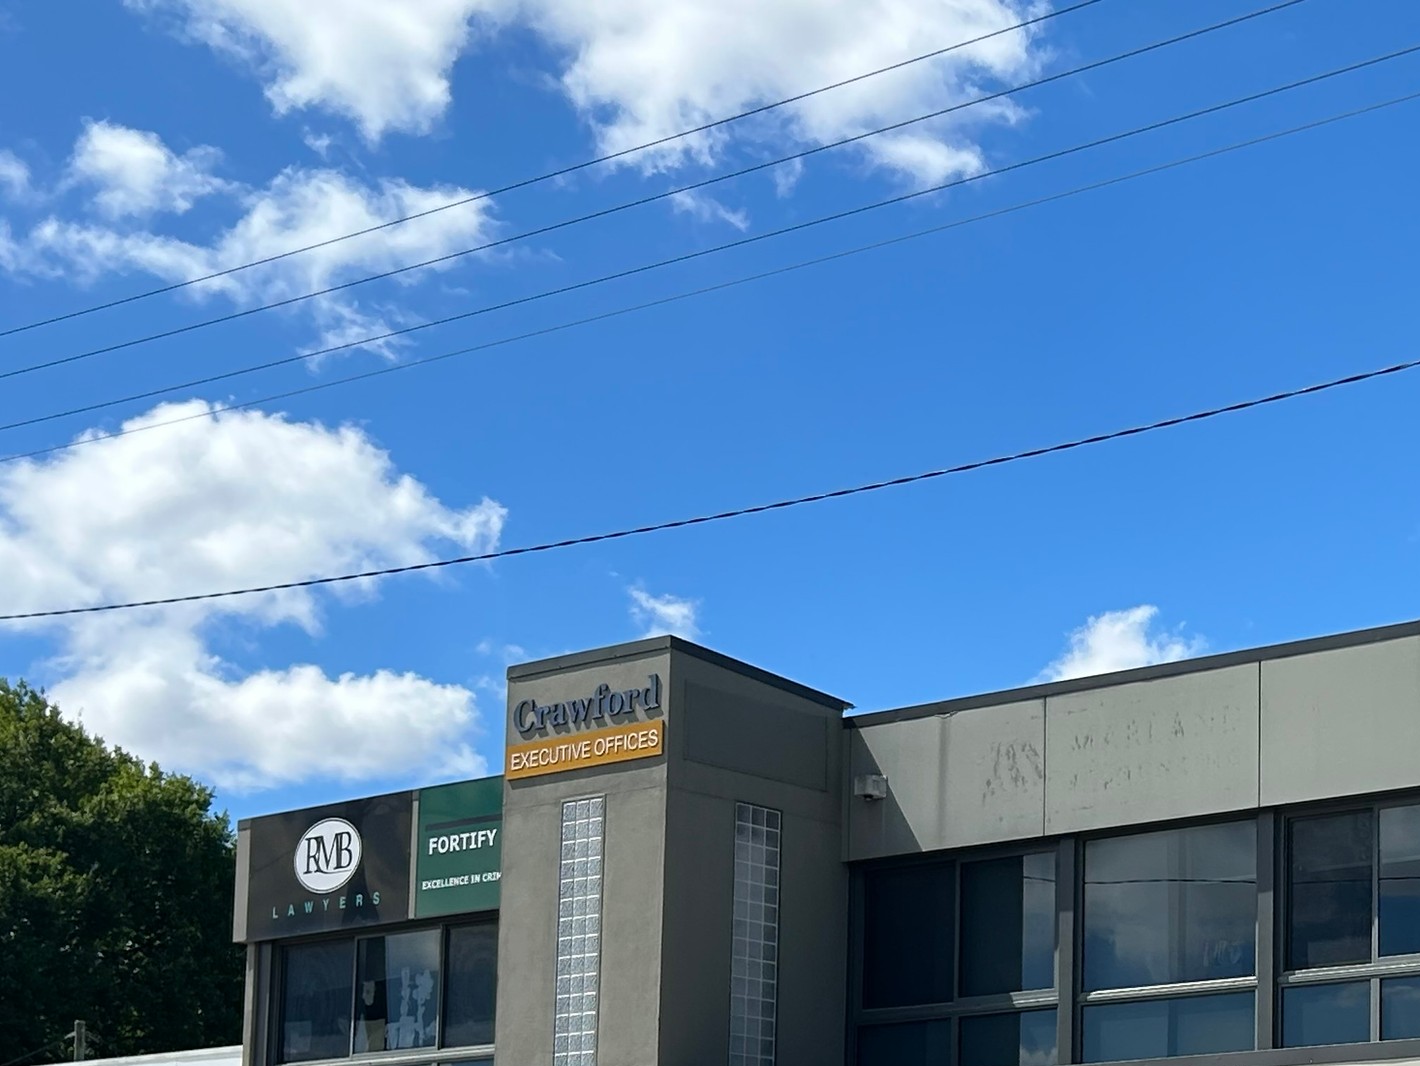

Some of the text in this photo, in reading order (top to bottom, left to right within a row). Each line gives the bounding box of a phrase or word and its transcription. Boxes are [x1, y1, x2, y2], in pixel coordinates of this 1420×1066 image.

[513, 673, 660, 733] Crawford
[511, 729, 659, 771] EXECUTIVE OFFICES
[303, 831, 353, 874] RMB
[428, 829, 498, 855] FORTIFY
[422, 876, 469, 890] EXCELLENCE
[470, 874, 481, 884] IN
[272, 892, 381, 919] LAWYERS
